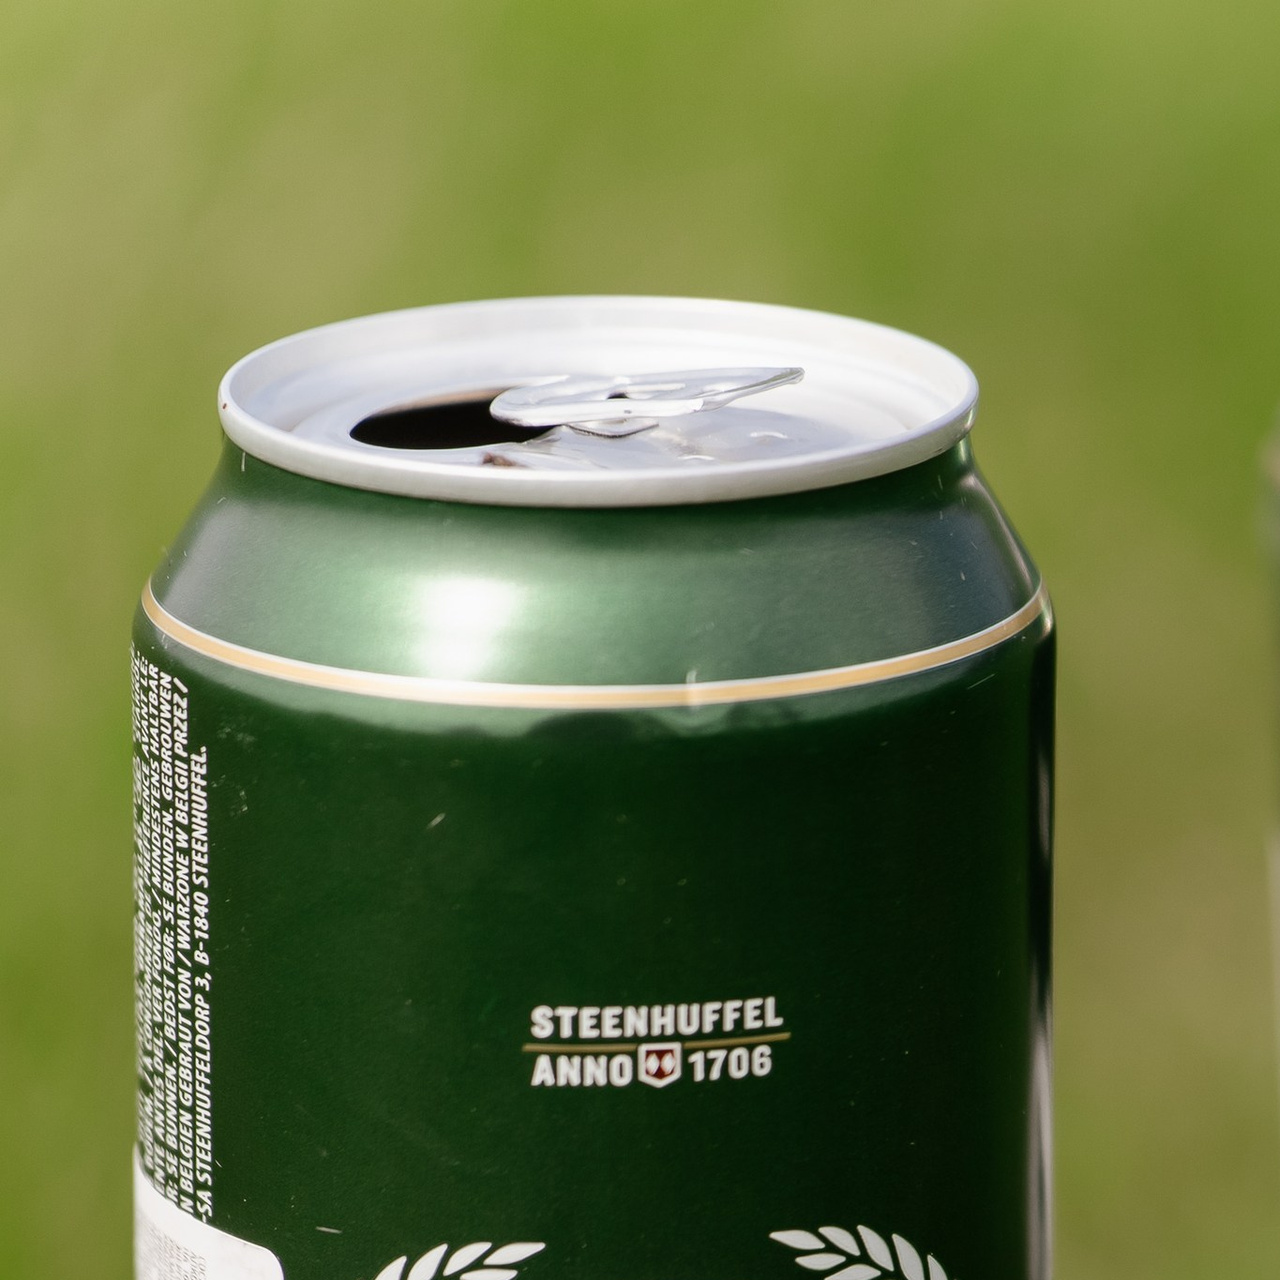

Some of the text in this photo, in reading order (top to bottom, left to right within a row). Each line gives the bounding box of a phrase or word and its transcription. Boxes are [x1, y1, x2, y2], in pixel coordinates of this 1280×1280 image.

[139, 656, 148, 688] LE:
[173, 677, 188, 693] /
[140, 688, 150, 759] AVANT
[148, 662, 160, 756] HALTBAR
[160, 671, 173, 801] GEBROUWEN
[173, 692, 188, 757] PRZEZ
[150, 758, 161, 888] MINDESTENS
[174, 759, 189, 825] BELGII
[190, 746, 208, 888] STEENHUFFEL.
[162, 807, 174, 896] BUNDEN.
[175, 826, 189, 848] W
[151, 887, 162, 905] /
[162, 897, 174, 925] SE
[176, 851, 191, 950] WARZONE
[193, 891, 210, 966] B-1840
[151, 908, 162, 982] FONDO.
[162, 926, 175, 975] FØR:
[177, 951, 192, 967] /
[151, 984, 163, 1023] VER
[163, 974, 176, 1041] BEDST
[177, 967, 192, 1010] VON
[194, 972, 212, 991] 3,
[152, 1026, 164, 1073] DEL:
[164, 1039, 177, 1058] /
[530, 996, 784, 1039] STEENHUFFEL
[178, 1012, 193, 1107] GEBRAUT
[194, 993, 212, 1186] STEENHUFFELDORP
[530, 1044, 773, 1088] ANNO 1706
[153, 1074, 165, 1142] ANTES
[164, 1060, 178, 1150] BUNNEN.
[165, 1149, 178, 1178] SE
[178, 1109, 194, 1194] BELGIEN
